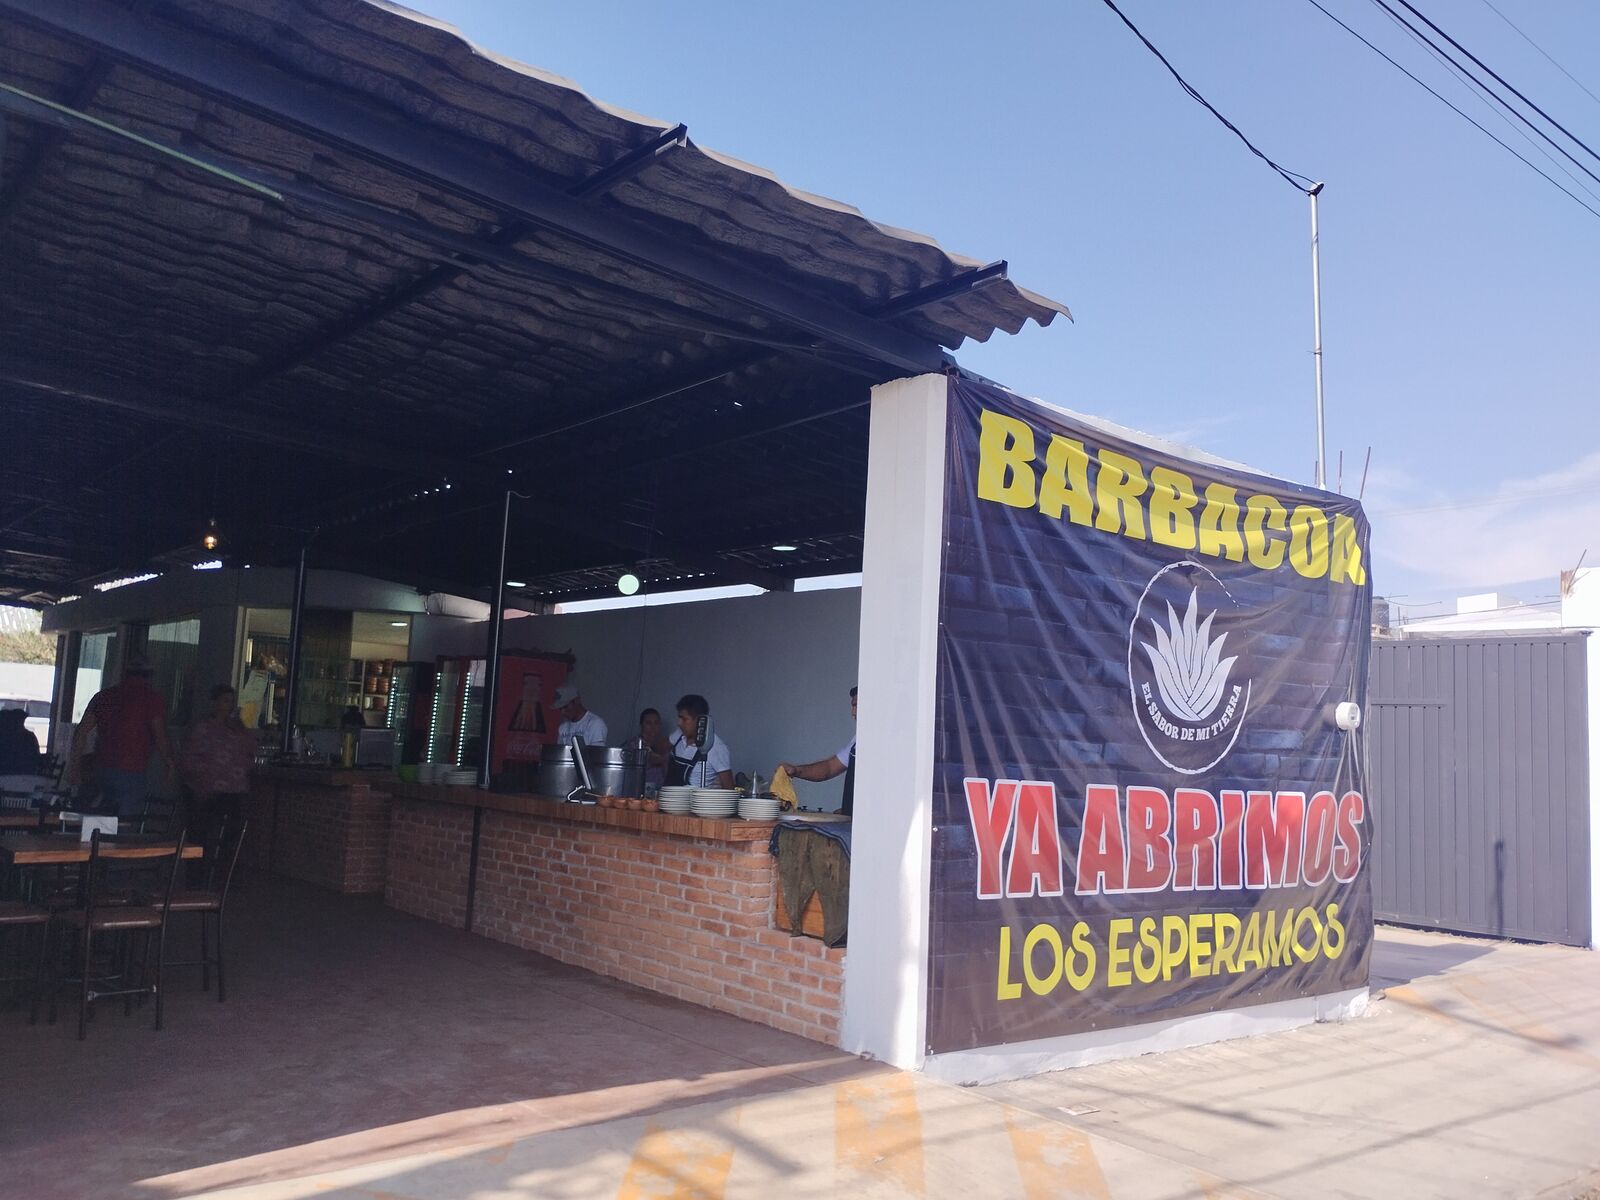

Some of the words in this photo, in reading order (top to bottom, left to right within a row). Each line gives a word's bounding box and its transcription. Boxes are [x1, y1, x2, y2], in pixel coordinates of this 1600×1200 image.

[978, 409, 1366, 586] BARBACOA
[1141, 681, 1152, 705] EL
[1149, 702, 1179, 741] SABOR
[1180, 728, 1194, 741] DE
[1196, 727, 1211, 741] MI
[1211, 684, 1242, 736] TIERRA
[963, 778, 1064, 899] YA
[1075, 783, 1365, 895] ABRIMOS
[997, 921, 1097, 1000] LOS
[1108, 904, 1346, 987] ESPERAMOS
